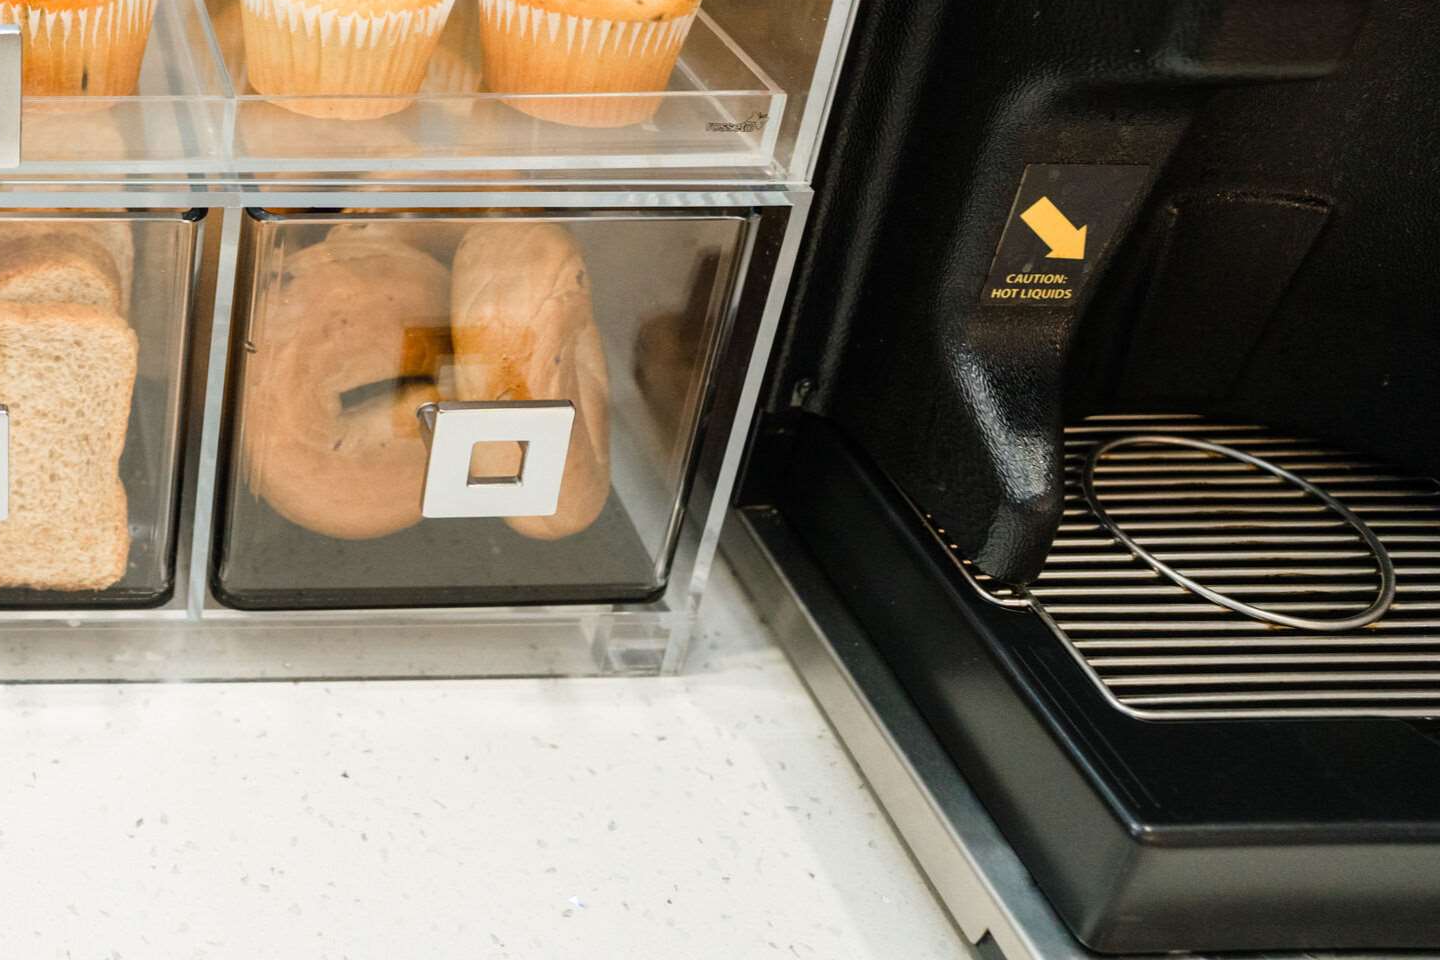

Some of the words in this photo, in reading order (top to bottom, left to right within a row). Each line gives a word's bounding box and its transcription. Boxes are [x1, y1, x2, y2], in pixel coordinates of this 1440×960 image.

[1006, 274, 1068, 284] CAUTION:
[991, 288, 1019, 298] HOT
[1020, 288, 1072, 299] LIQUIDS
